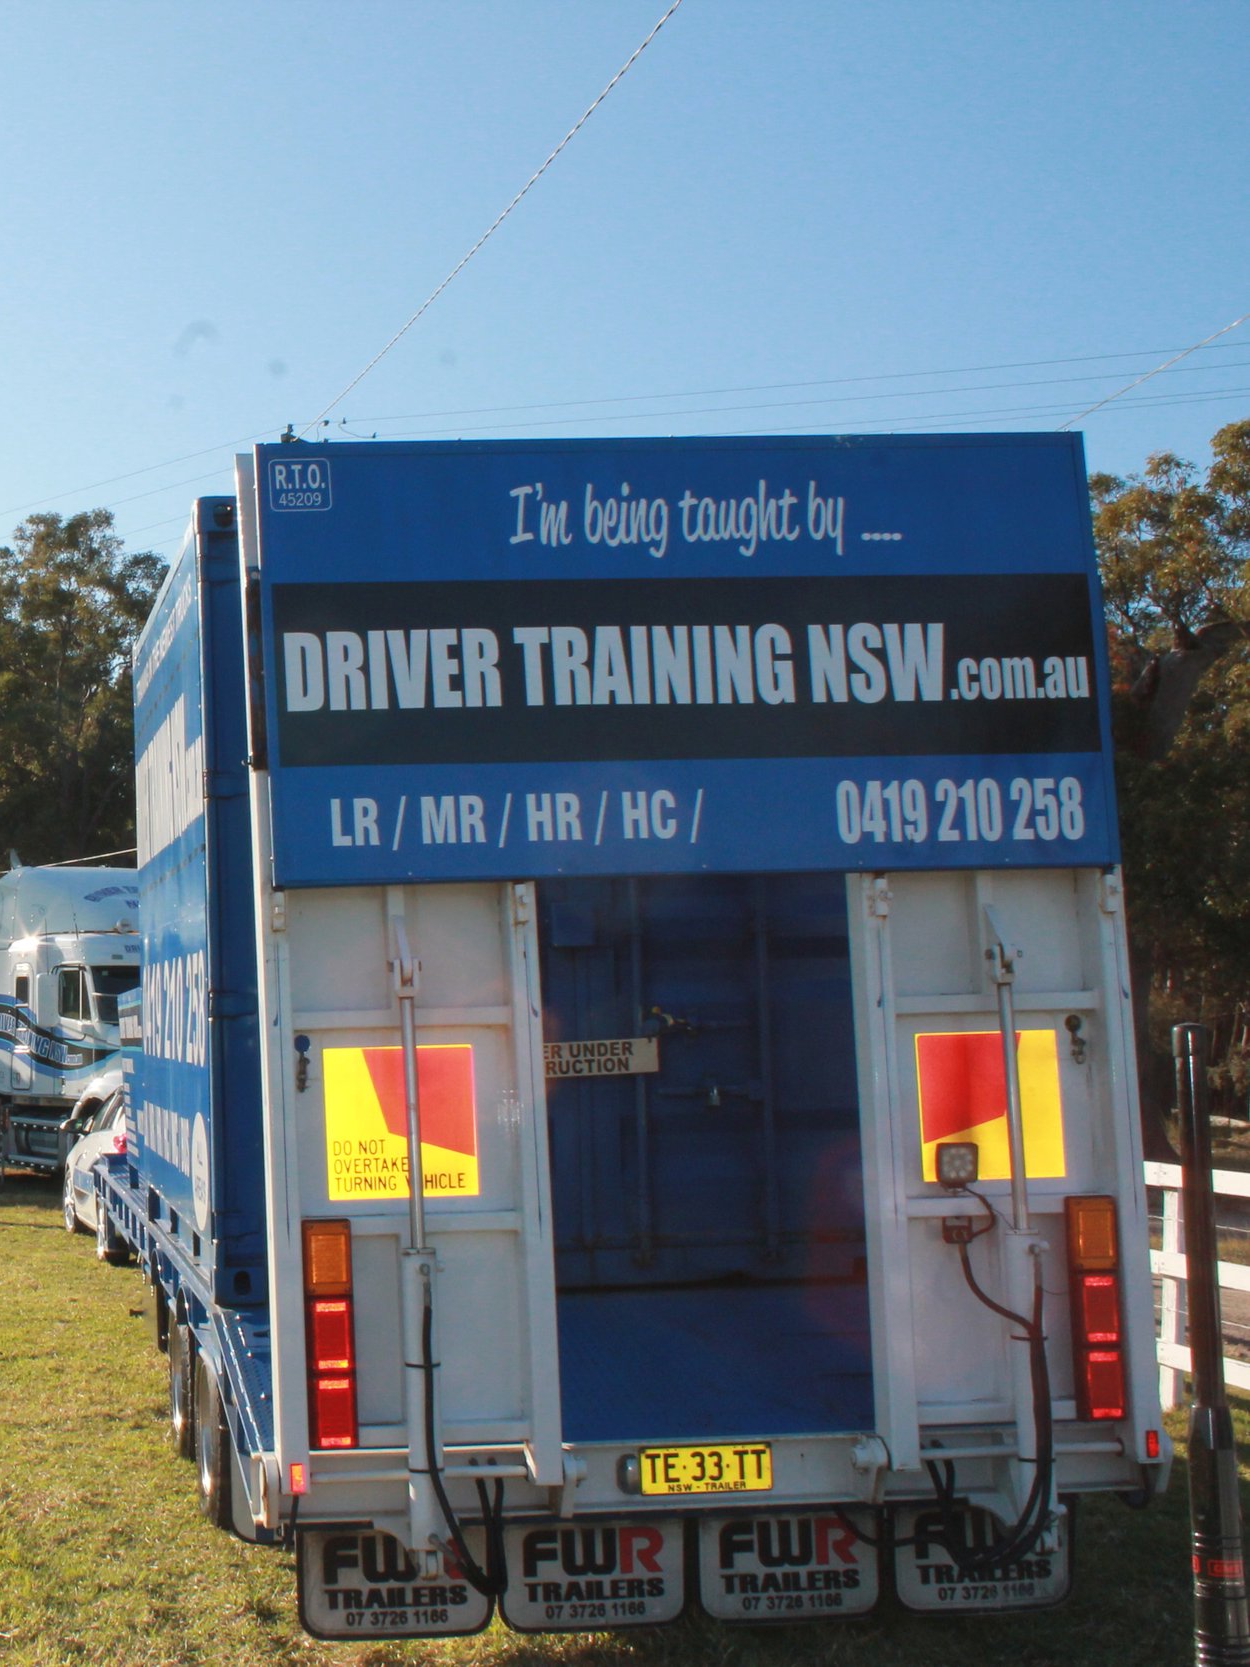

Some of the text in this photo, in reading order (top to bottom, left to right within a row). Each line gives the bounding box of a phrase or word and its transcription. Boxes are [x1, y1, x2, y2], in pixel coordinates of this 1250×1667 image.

[275, 464, 326, 489] R.T.O.
[279, 492, 322, 507] 45209
[509, 482, 573, 547] I'm
[584, 482, 669, 558] being
[678, 479, 800, 557] taught
[807, 480, 844, 556] by
[283, 627, 503, 713] DRIVER
[513, 623, 796, 706] TRAINING
[330, 797, 381, 848] LR
[420, 795, 487, 845] MR
[525, 792, 583, 842] HR
[621, 789, 677, 840] HC
[836, 776, 1085, 845] 0419 210 258
[163, 955, 184, 1064] 210
[185, 948, 206, 1068] 258
[569, 1041, 634, 1059] UNDER
[545, 1057, 630, 1076] RUCTION
[333, 1139, 386, 1156] DO NOT
[333, 1157, 410, 1175] OVERTAKE
[335, 1175, 397, 1193] TURNING
[668, 1483, 693, 1493] NSW
[705, 1481, 747, 1491] TRAILER
[523, 1526, 664, 1578] FWR
[719, 1515, 859, 1569] FWR
[524, 1576, 665, 1603] TRAILERS
[719, 1568, 860, 1594] TRAILERS
[324, 1584, 468, 1610] TRAILERS
[741, 1596, 761, 1611] 07
[937, 1586, 957, 1602] 07
[346, 1611, 365, 1627] 07
[545, 1605, 564, 1620] 07
